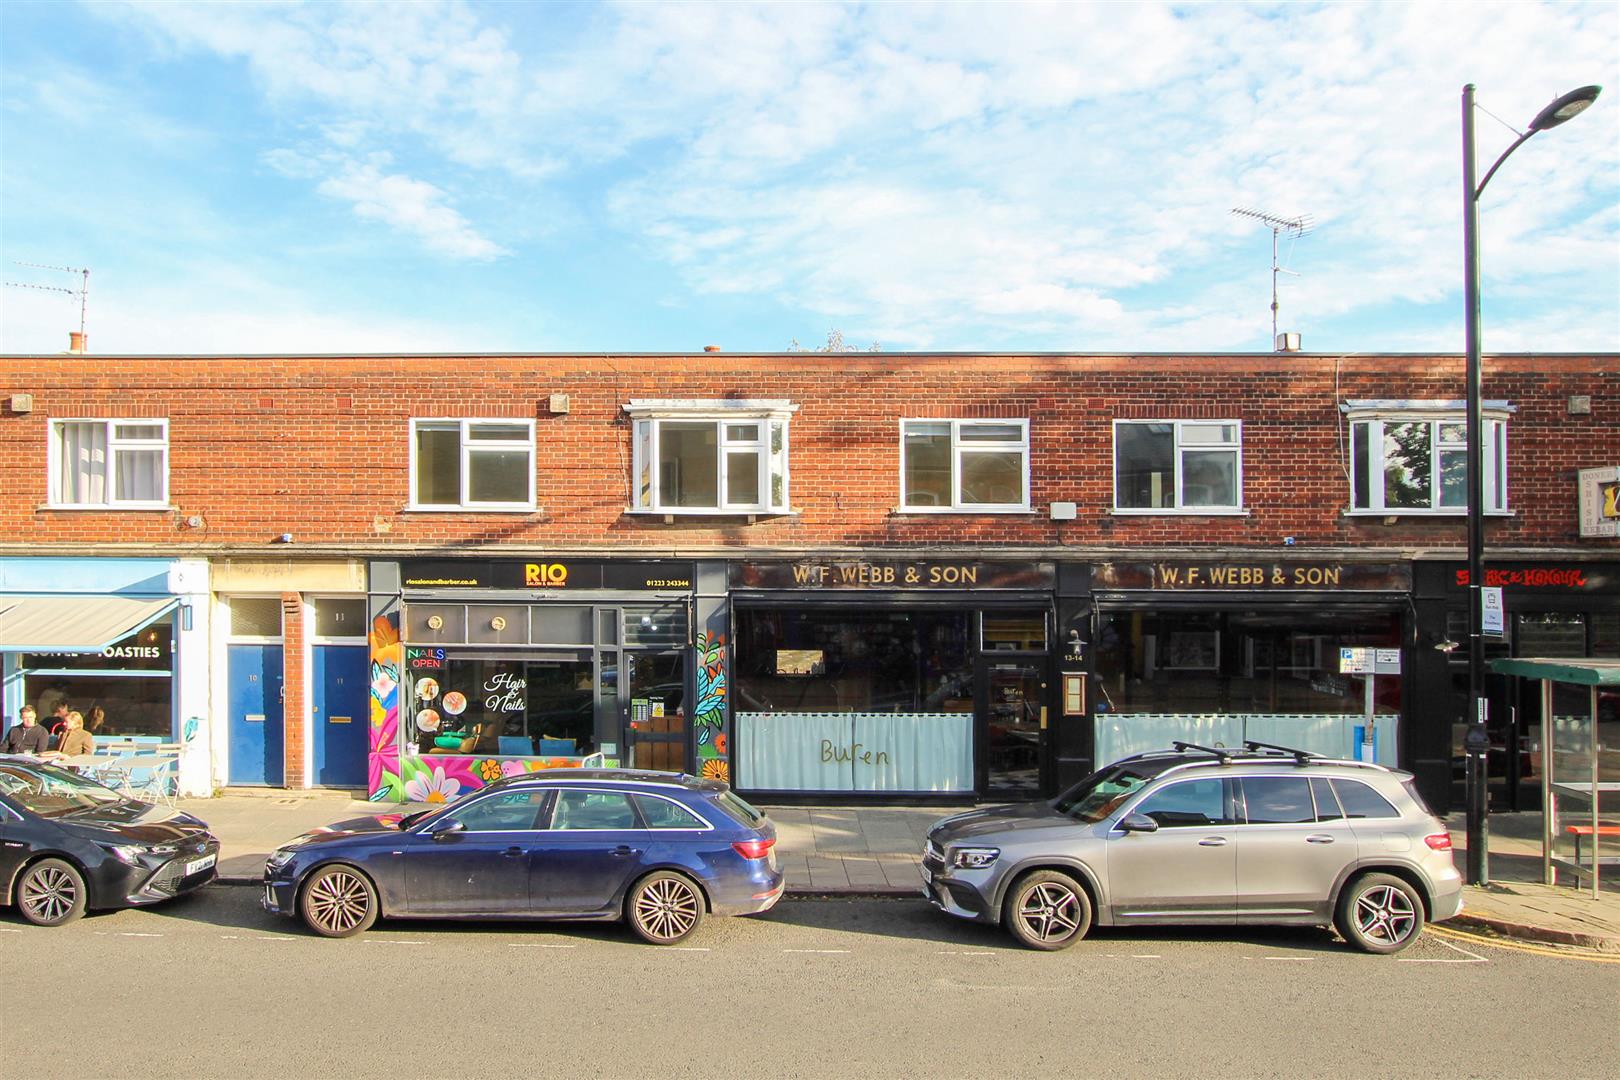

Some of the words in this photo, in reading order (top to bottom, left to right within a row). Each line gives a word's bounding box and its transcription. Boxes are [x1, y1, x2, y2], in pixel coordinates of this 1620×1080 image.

[526, 563, 568, 582] RIO
[905, 566, 920, 583] &
[930, 566, 977, 583] SON
[1271, 567, 1286, 585] &
[1294, 567, 1339, 585] SON
[408, 648, 445, 660] NAILS
[412, 659, 440, 668] OPEN
[248, 674, 258, 682] 10
[484, 672, 528, 692] Hair
[507, 688, 520, 700] &
[485, 694, 527, 713] Nails
